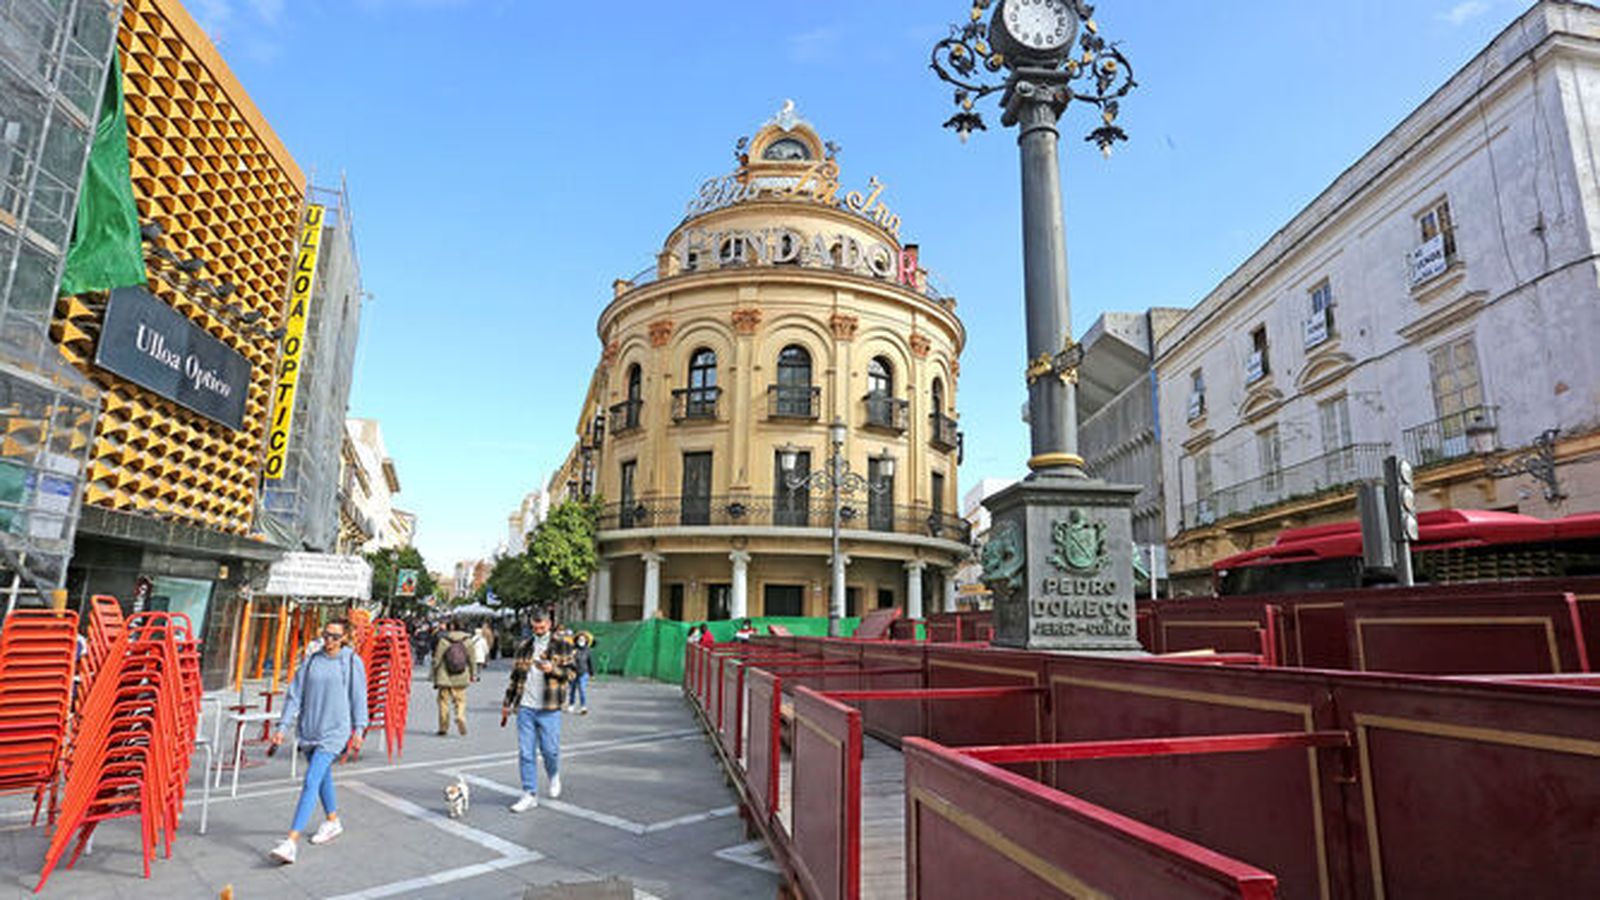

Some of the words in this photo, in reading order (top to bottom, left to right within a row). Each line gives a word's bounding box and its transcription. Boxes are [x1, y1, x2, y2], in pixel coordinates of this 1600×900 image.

[292, 207, 323, 318] ULLOA
[682, 226, 919, 290] FUNDADOR
[136, 322, 181, 370] Ulloa
[185, 353, 231, 398] Optico
[265, 337, 300, 475] OPTICO
[1031, 599, 1131, 620] DOMECQ
[1042, 577, 1118, 596] PEDRO
